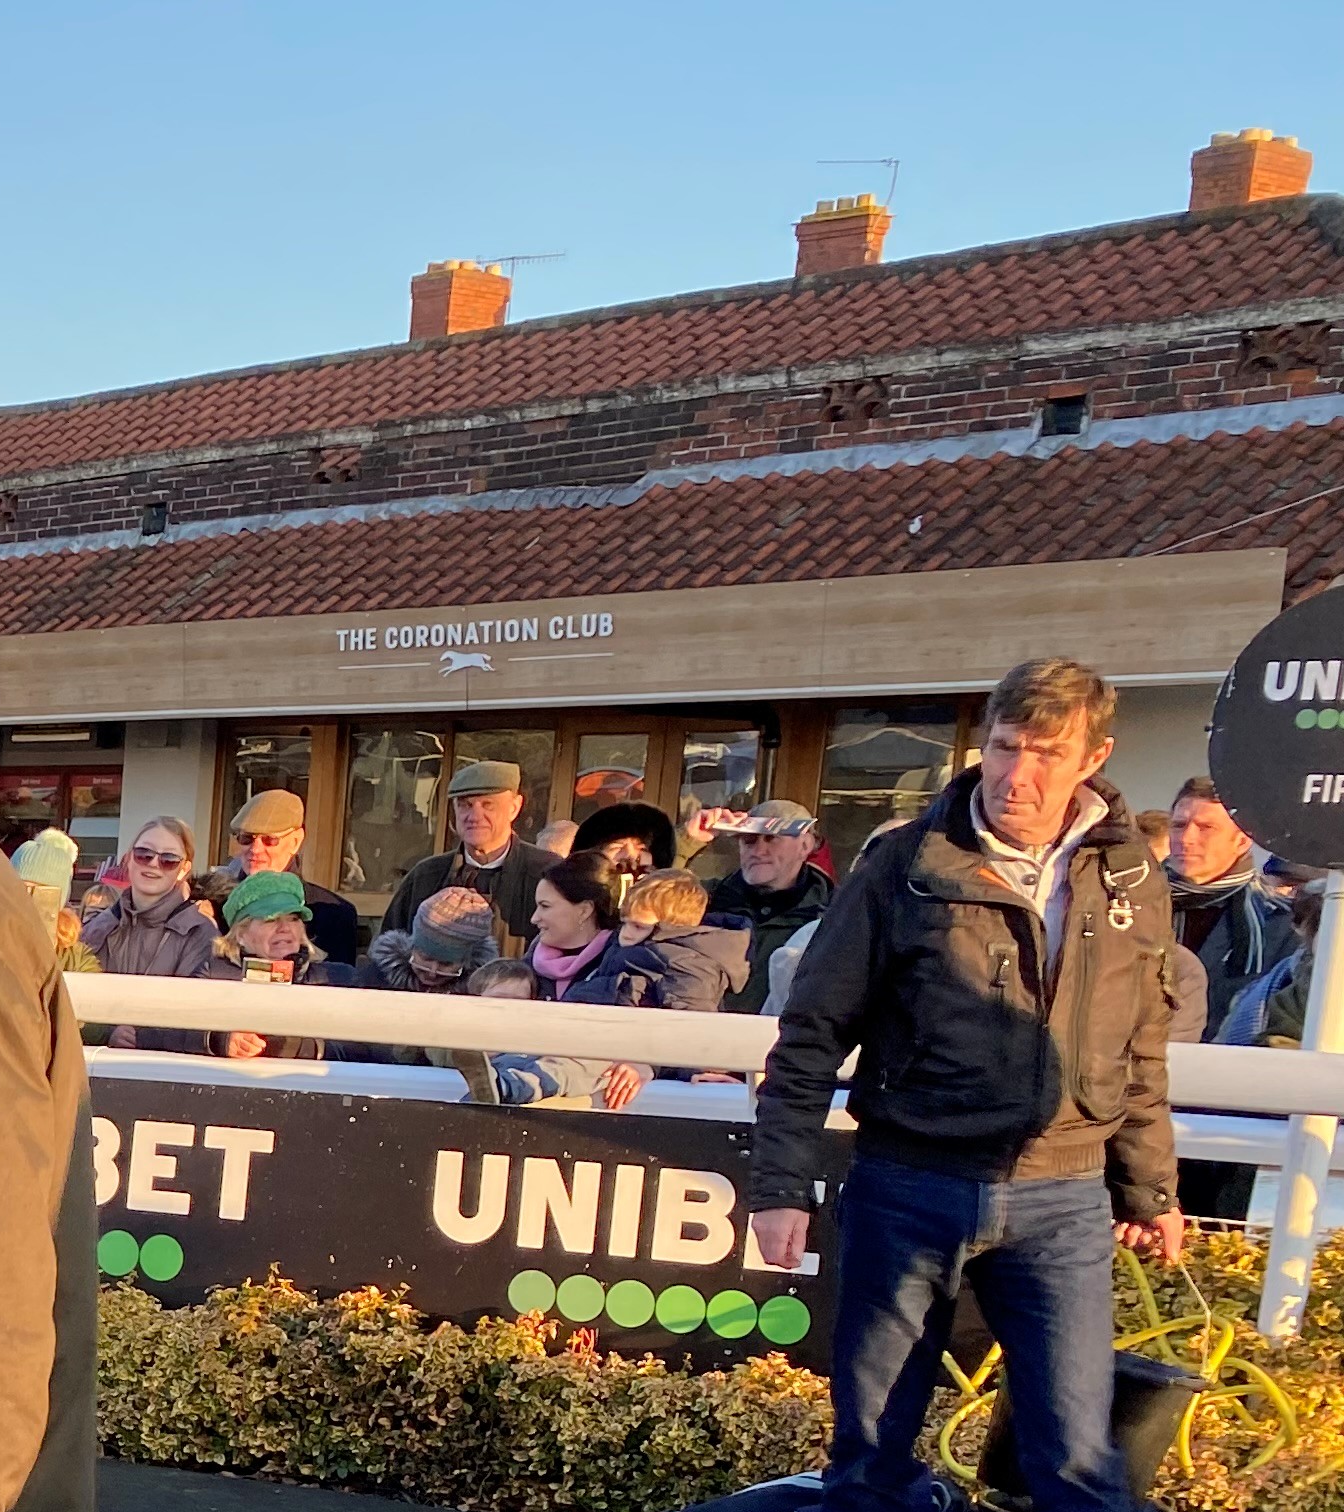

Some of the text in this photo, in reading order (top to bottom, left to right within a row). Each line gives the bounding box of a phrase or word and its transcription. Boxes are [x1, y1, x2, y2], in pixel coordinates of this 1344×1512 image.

[335, 612, 614, 651] THE CORONATION CLUB
[1263, 660, 1344, 702] UN
[432, 1149, 846, 1276] UNIB
